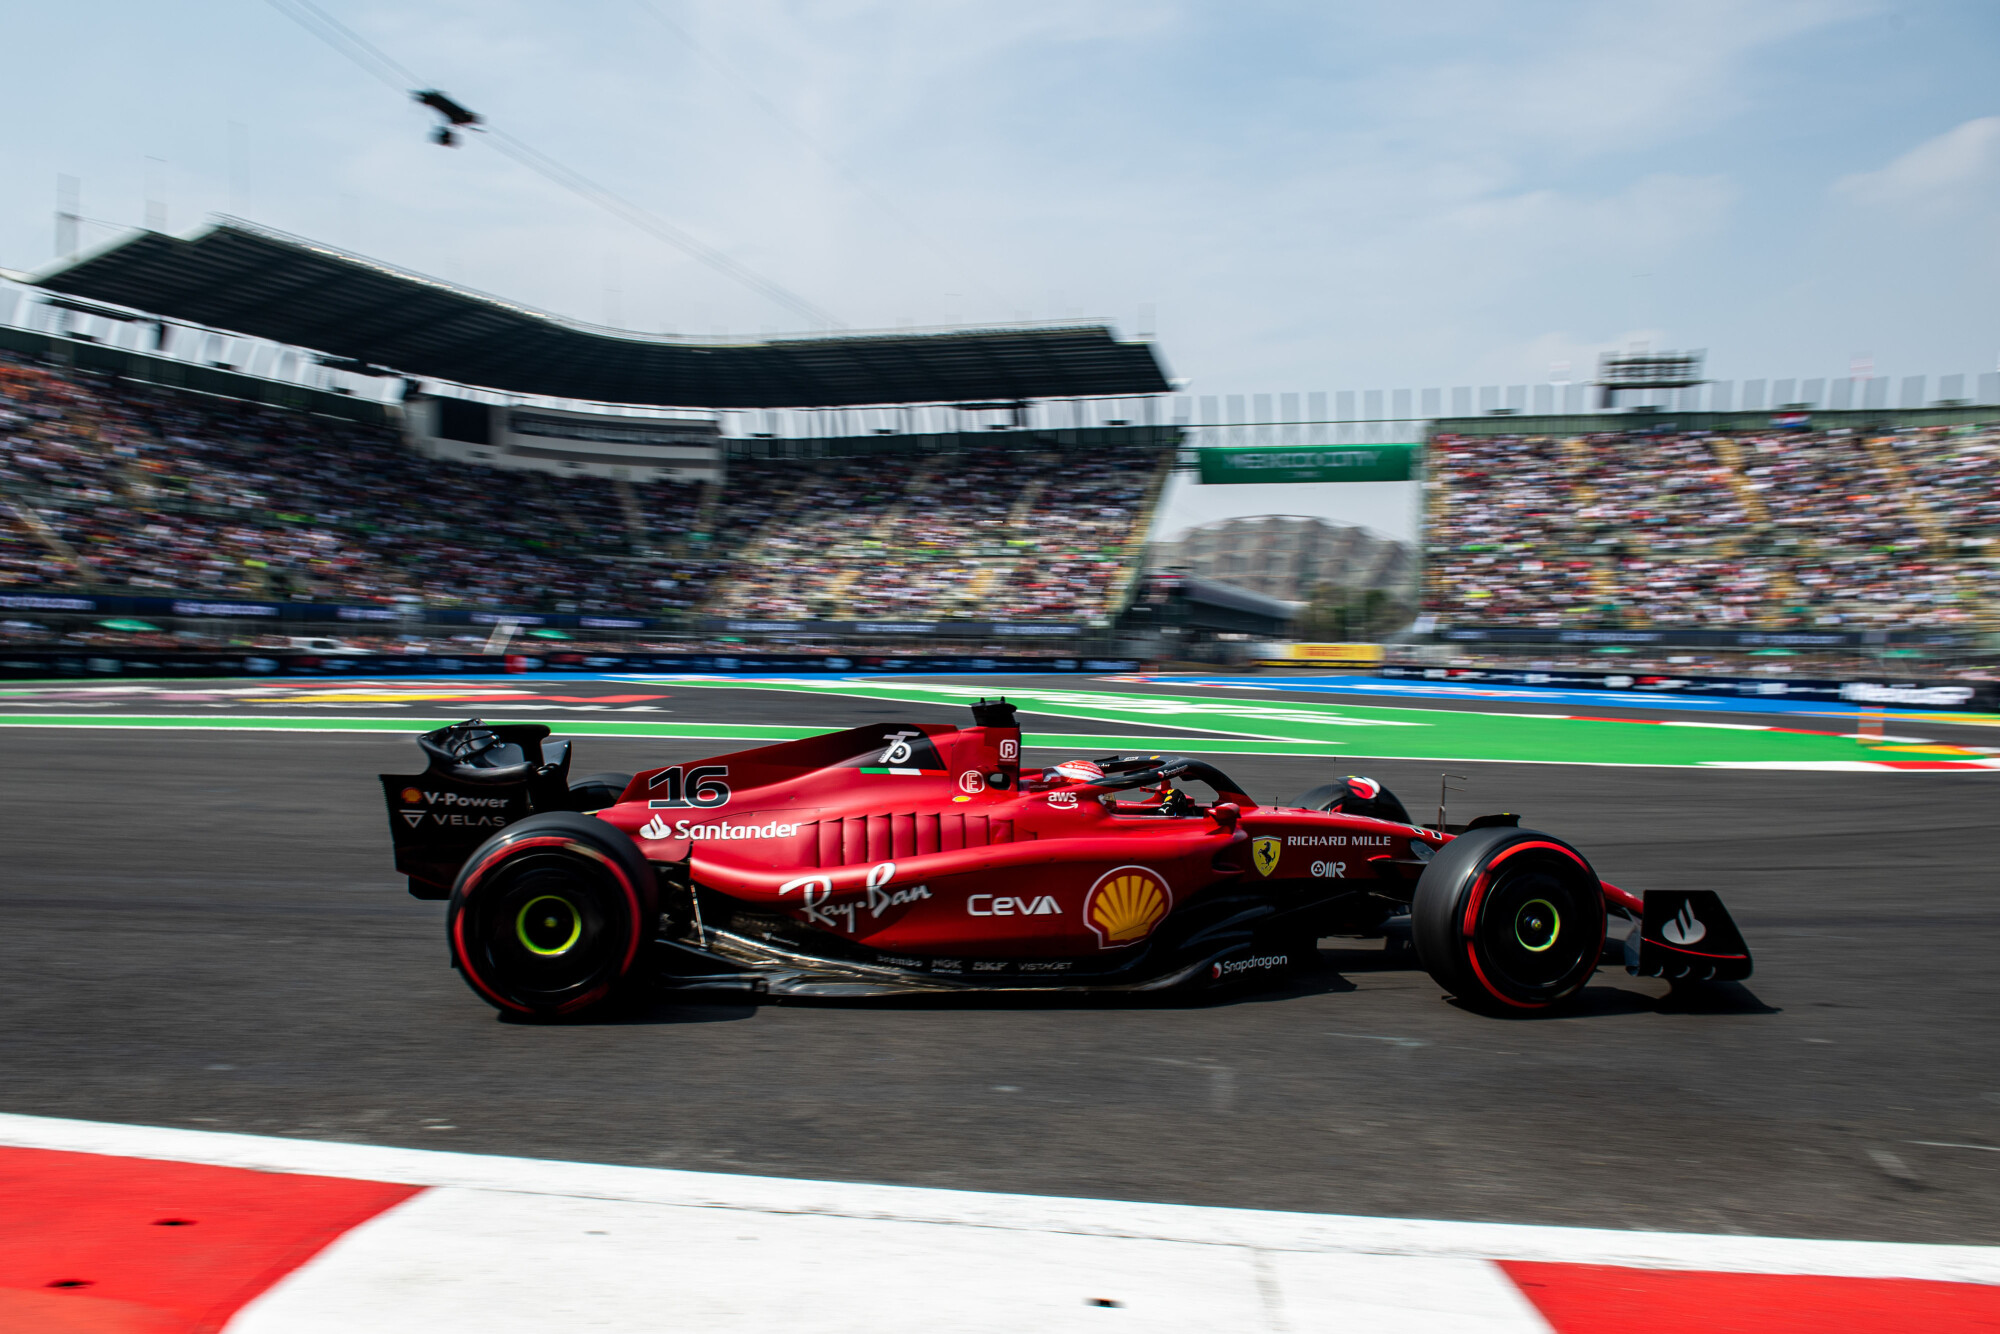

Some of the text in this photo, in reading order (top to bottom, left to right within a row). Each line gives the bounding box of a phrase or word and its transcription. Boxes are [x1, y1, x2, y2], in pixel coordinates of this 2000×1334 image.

[648, 765, 731, 809] 16
[423, 791, 509, 808] V-Power
[1048, 791, 1077, 803] aws
[432, 814, 506, 827] VELAS
[674, 819, 802, 840] Santander
[1287, 836, 1391, 846] RICHARD MILLE
[1223, 955, 1288, 974] Snapdragon
